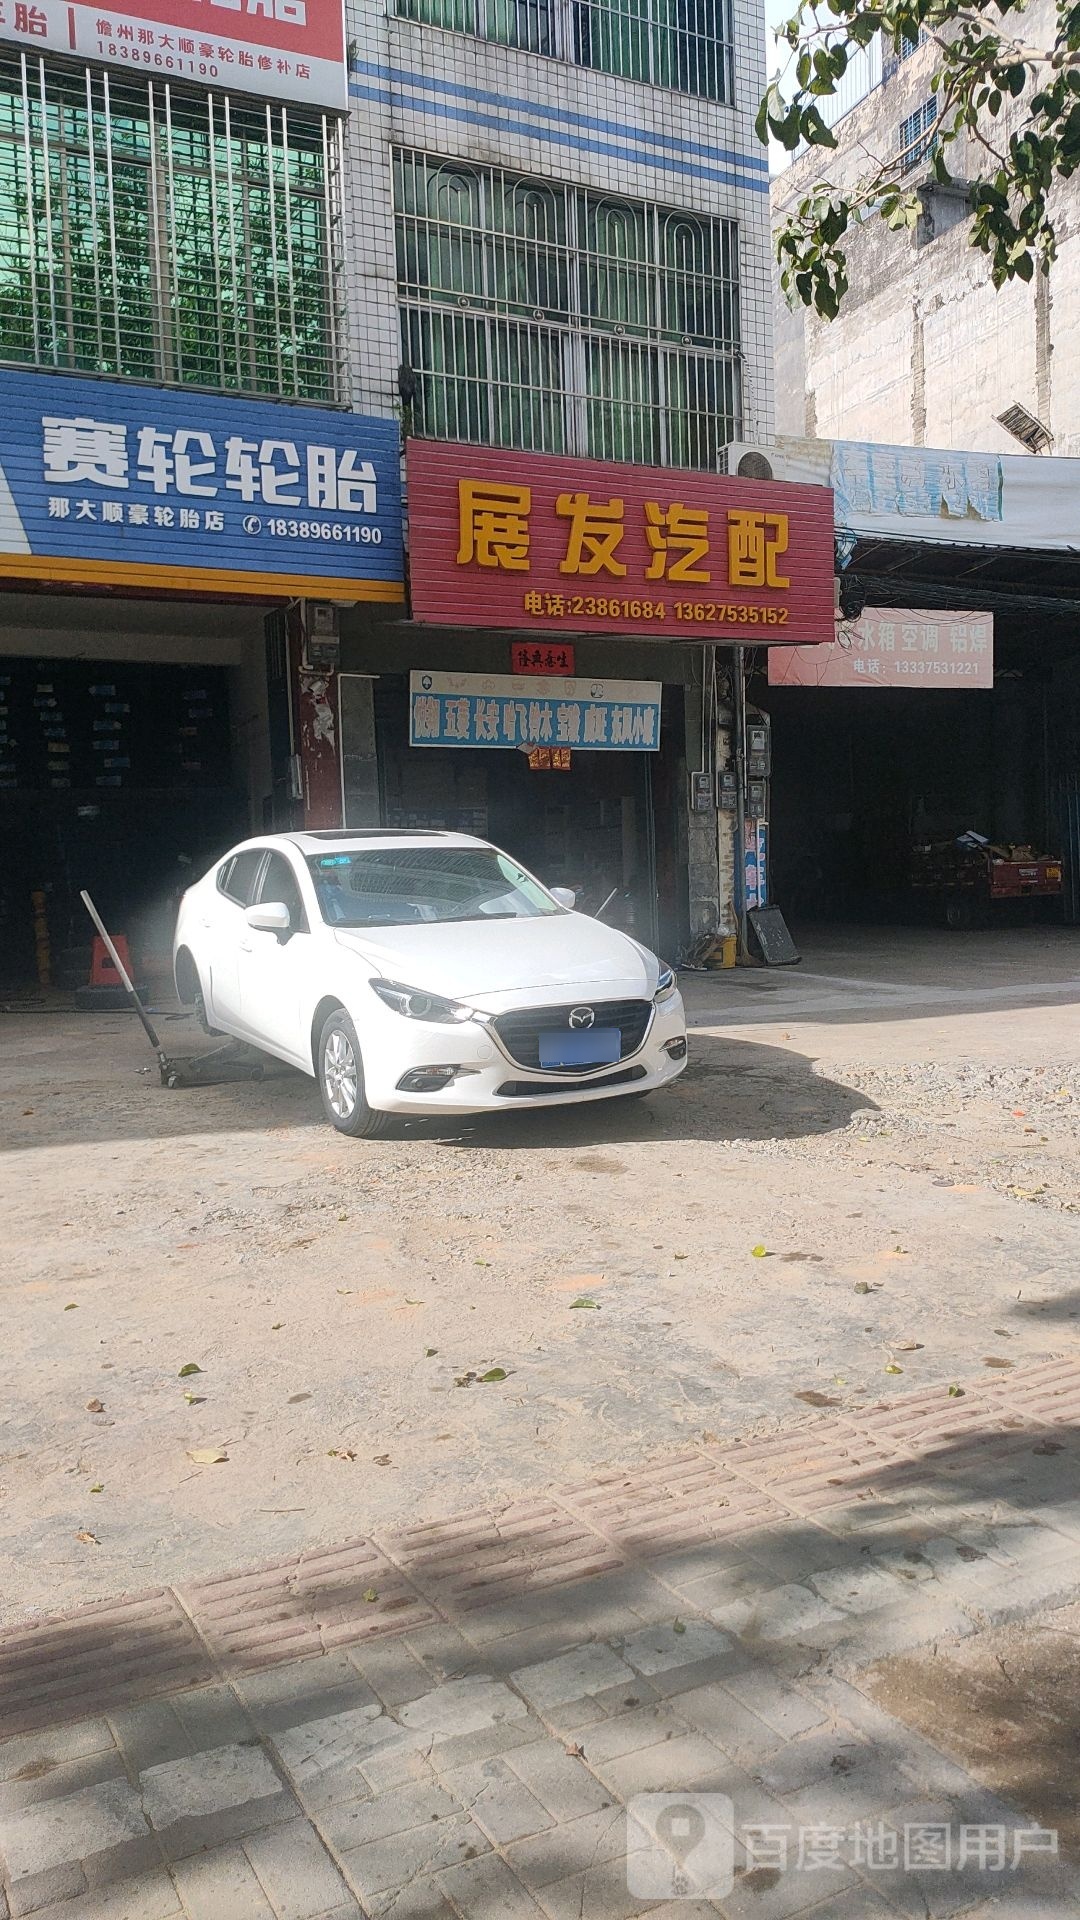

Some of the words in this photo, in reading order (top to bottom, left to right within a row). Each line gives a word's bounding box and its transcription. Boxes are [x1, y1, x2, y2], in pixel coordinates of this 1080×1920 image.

[96, 18, 311, 80] 儋州那大顺豪轮胎修补店
[96, 41, 218, 78] 18389661190
[42, 416, 377, 514] 赛轮轮胎
[48, 497, 225, 532] 那大顺豪轮胎店
[267, 517, 382, 545] 18389661190
[456, 479, 791, 589] 展发汽配
[673, 601, 790, 626] 13627535152
[858, 622, 895, 652] 水箱
[901, 622, 939, 653] 空调
